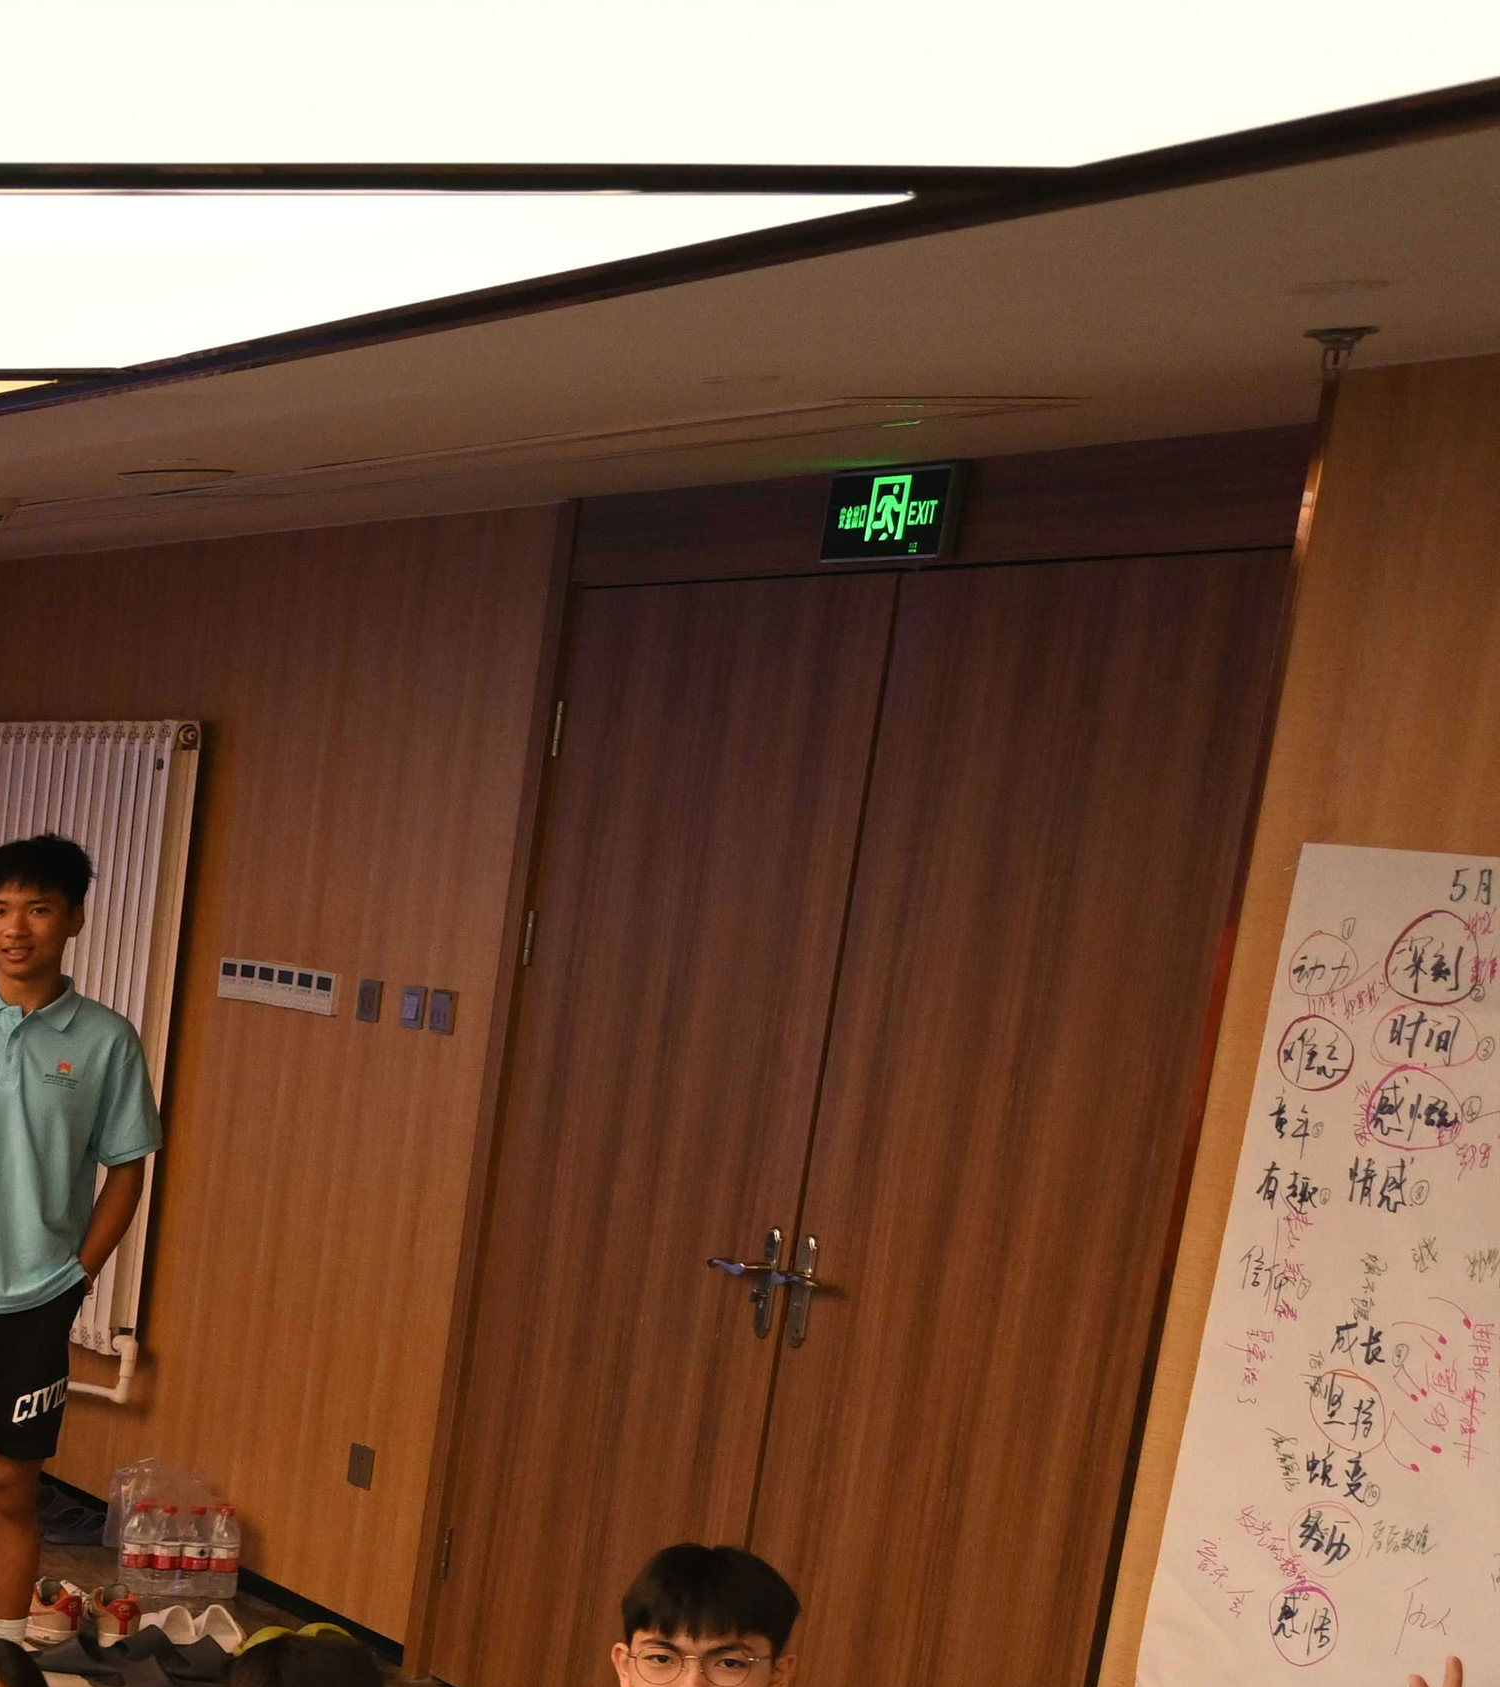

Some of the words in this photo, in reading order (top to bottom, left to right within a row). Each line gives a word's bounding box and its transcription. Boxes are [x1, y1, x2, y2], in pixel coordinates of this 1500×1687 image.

[907, 500, 938, 526] EXIT
[1293, 951, 1351, 990] 动力
[1391, 936, 1464, 993] 深刻
[1282, 1027, 1351, 1084] 难忘
[1389, 1010, 1461, 1067] 时间
[1256, 1161, 1318, 1214] 有趣
[1349, 1155, 1414, 1213] 情感
[1331, 1321, 1386, 1365] 成长
[1306, 1443, 1367, 1503] 蜕变
